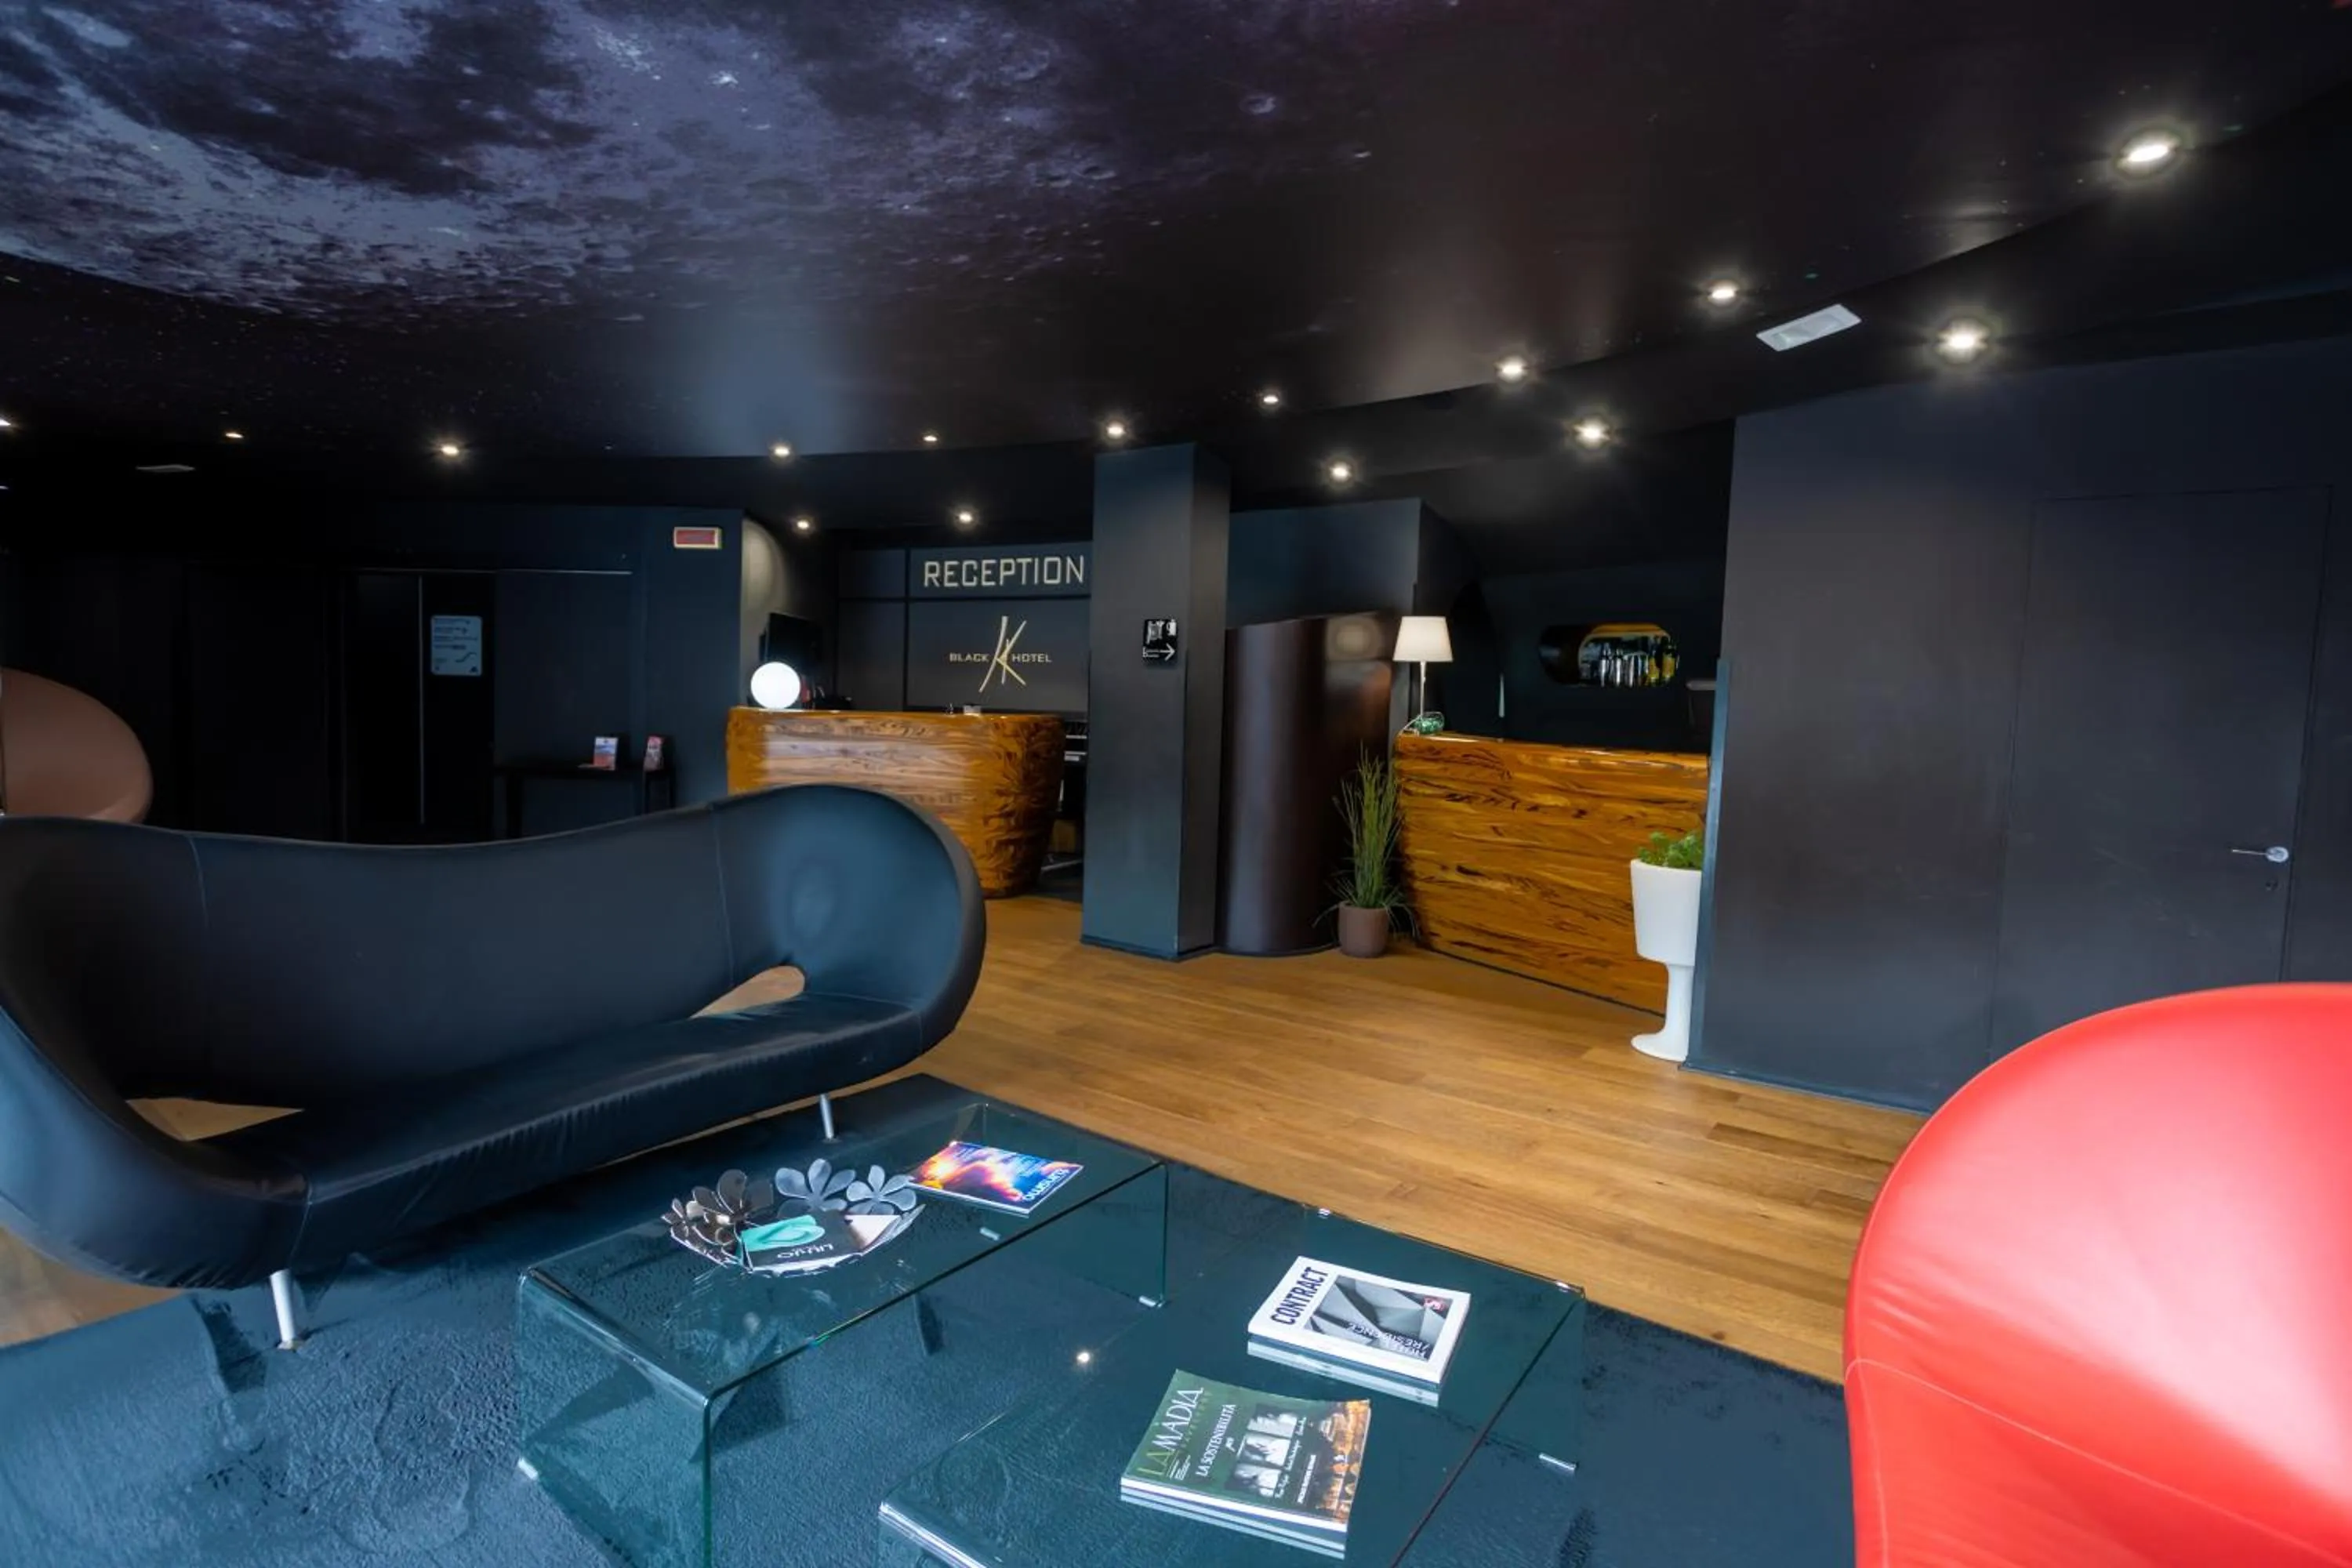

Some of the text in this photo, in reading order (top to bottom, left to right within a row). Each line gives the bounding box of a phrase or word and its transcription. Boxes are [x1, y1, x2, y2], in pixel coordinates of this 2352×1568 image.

[924, 555, 1085, 587] RECEPTION
[949, 652, 990, 662] BLACK
[1011, 652, 1052, 662] HOTEL
[1270, 1266, 1329, 1325] CONTRACT
